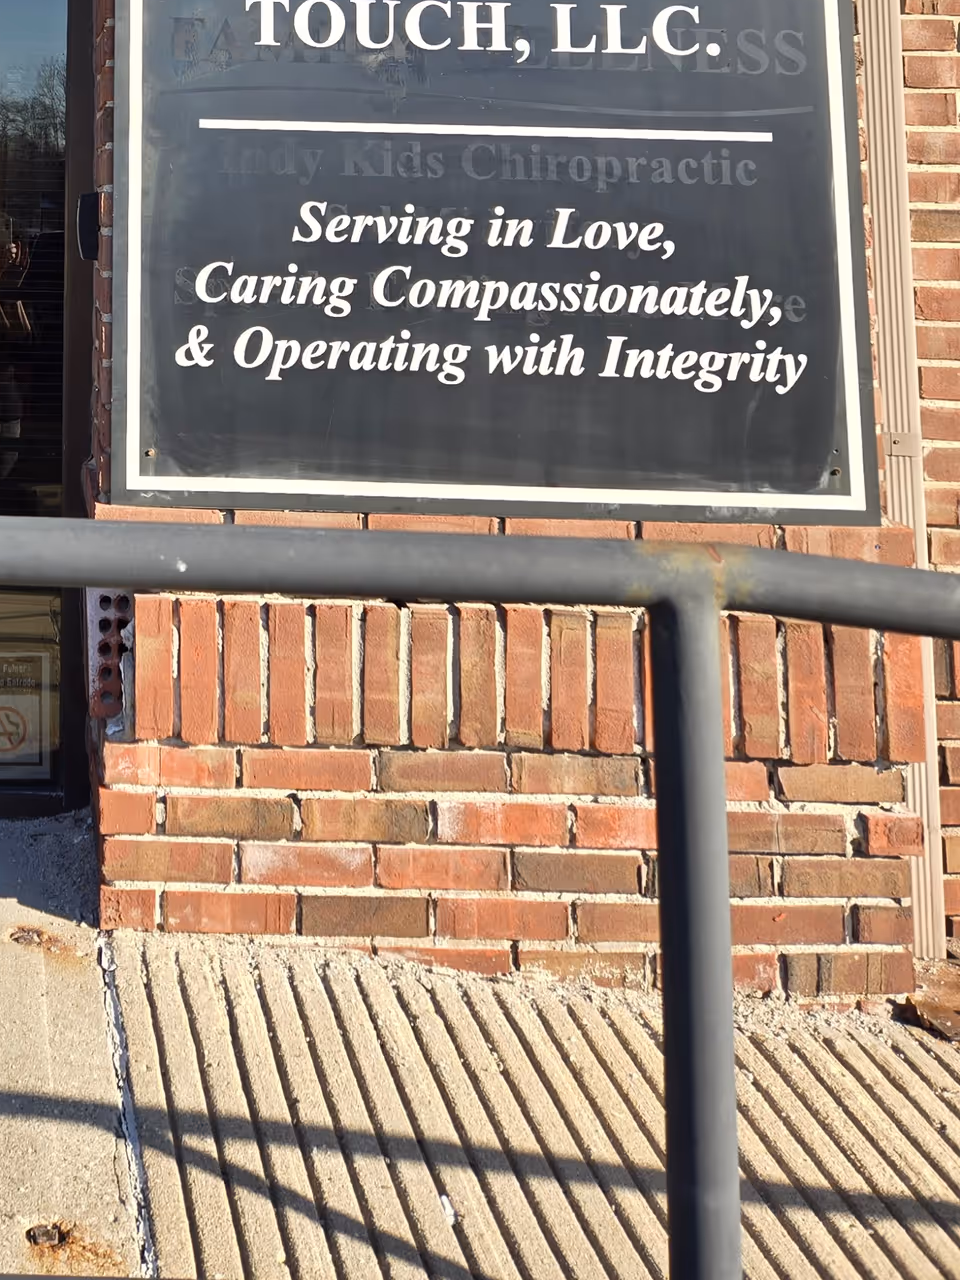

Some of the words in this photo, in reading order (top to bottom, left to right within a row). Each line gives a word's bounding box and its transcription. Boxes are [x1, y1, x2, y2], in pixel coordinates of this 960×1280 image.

[549, 3, 721, 57] LLC.
[340, 139, 445, 180] Kids
[461, 142, 758, 193] Chiropractic
[292, 201, 475, 258] Serving
[487, 206, 534, 248] in
[546, 207, 675, 260] Love,
[195, 261, 358, 318] Caring
[372, 265, 782, 330] Compassionately,
[174, 324, 215, 367] &
[233, 325, 472, 385] Operating
[484, 332, 585, 377] with
[598, 336, 808, 395] Integrity
